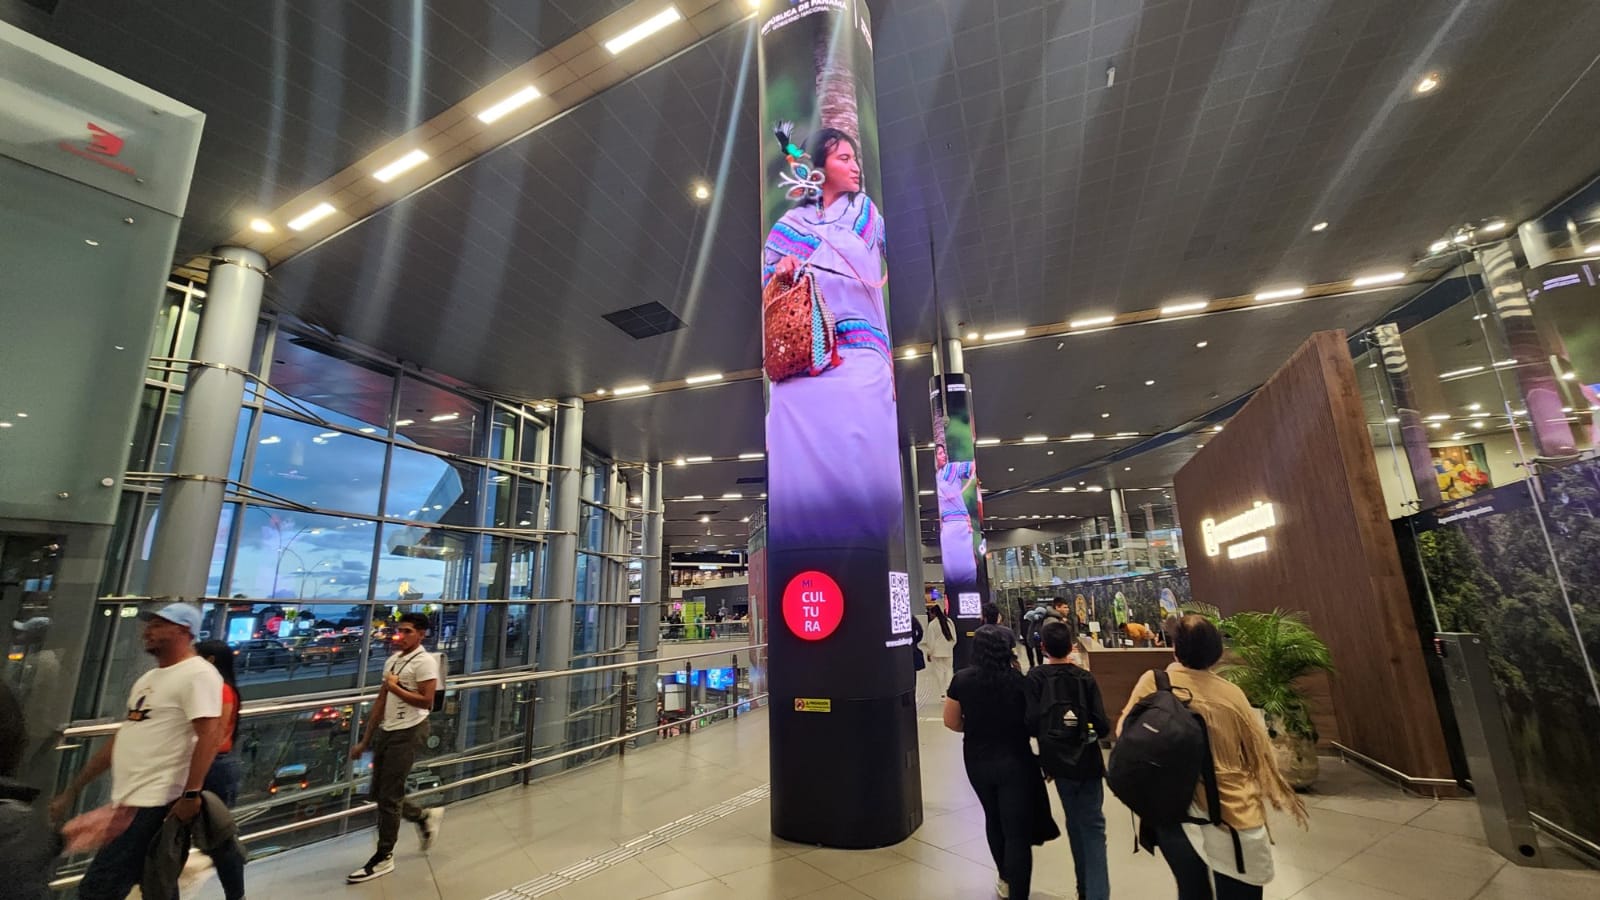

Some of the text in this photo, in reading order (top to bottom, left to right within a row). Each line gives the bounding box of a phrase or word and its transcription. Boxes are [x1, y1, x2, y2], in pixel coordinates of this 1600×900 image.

[798, 1, 810, 12] DE
[802, 579, 813, 588] MI
[802, 591, 826, 603] CUL
[802, 606, 819, 617] TU
[804, 620, 821, 632] RA
